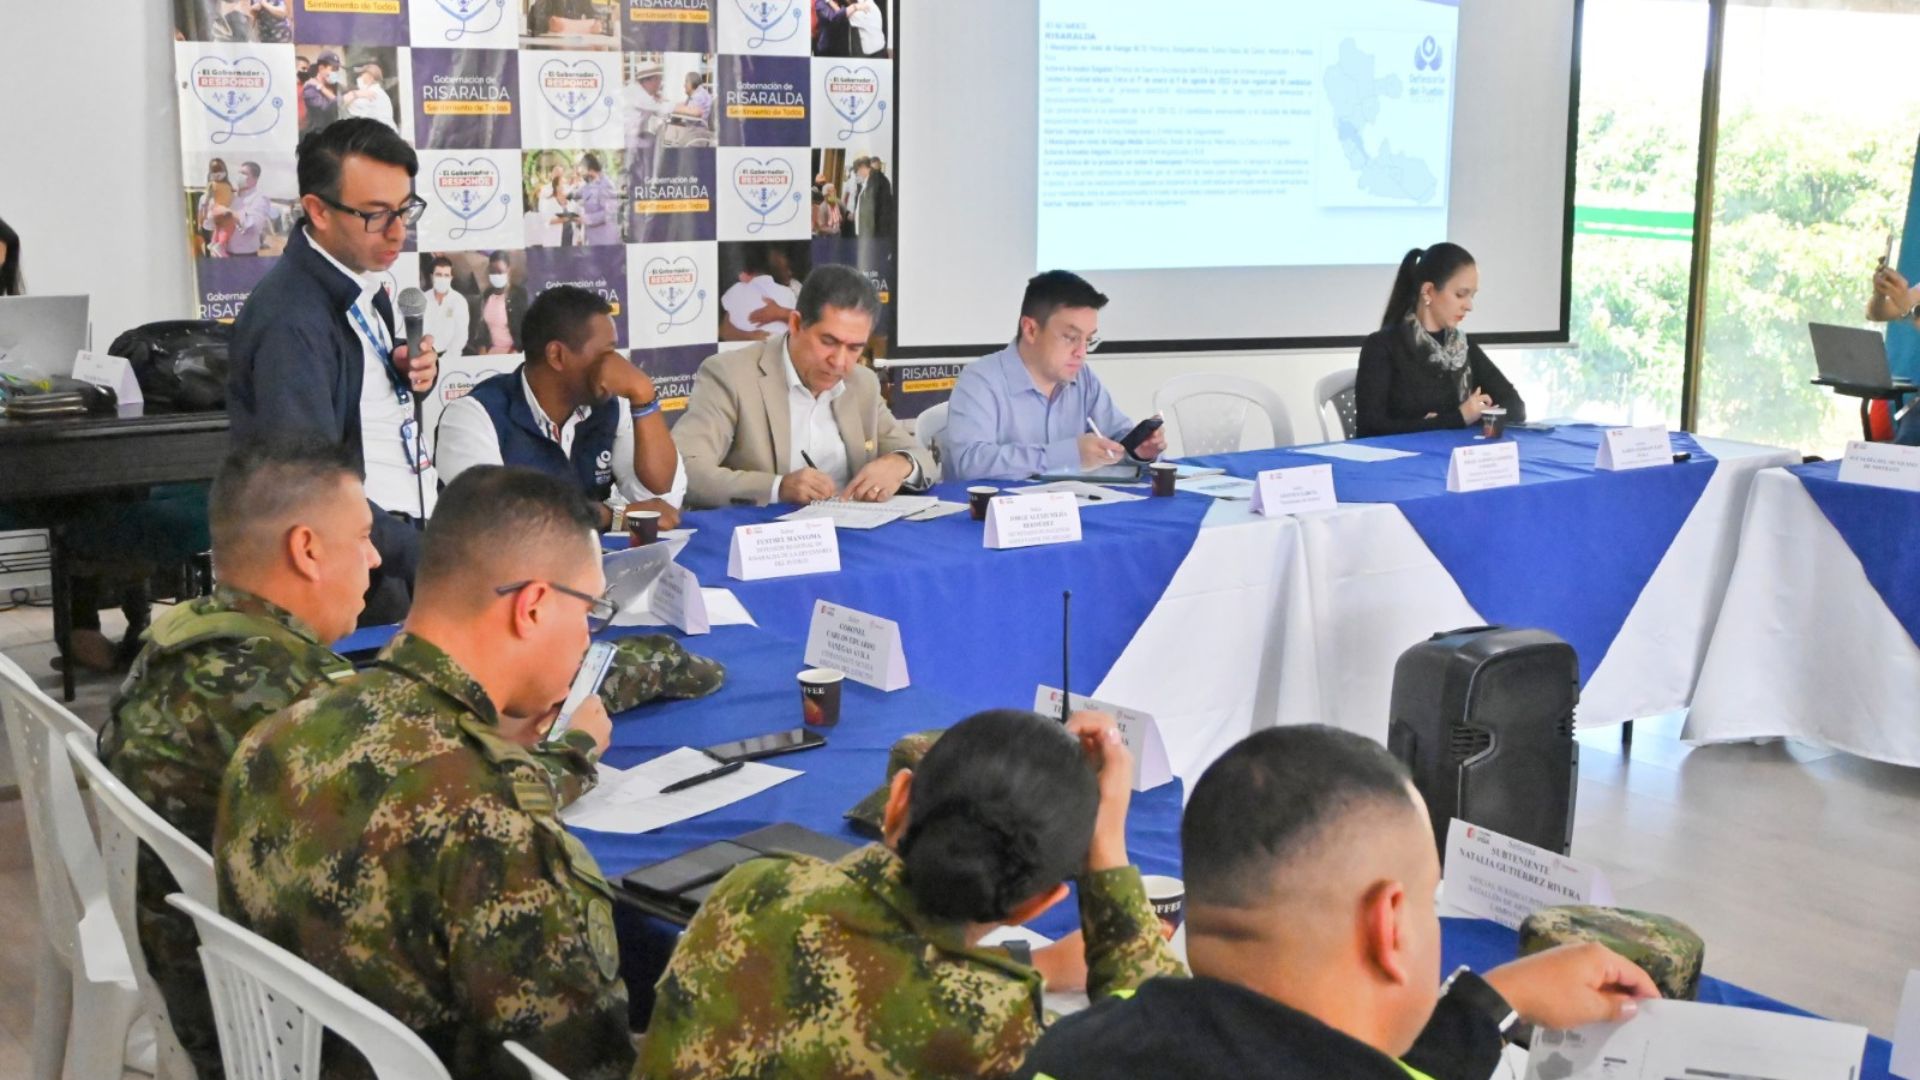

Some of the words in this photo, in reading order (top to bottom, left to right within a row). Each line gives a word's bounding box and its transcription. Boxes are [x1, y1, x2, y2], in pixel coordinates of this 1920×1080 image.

[422, 85, 510, 100] RISARALDA
[726, 91, 804, 105] RISARALDA
[634, 185, 709, 199] RISARALDA
[902, 365, 960, 380] RISARALD
[1491, 846, 1550, 876] SUBTENIENTE
[1459, 847, 1496, 870] NATALIA
[1496, 862, 1546, 888] GUTIERREZ
[1547, 880, 1582, 901] RIVERA
